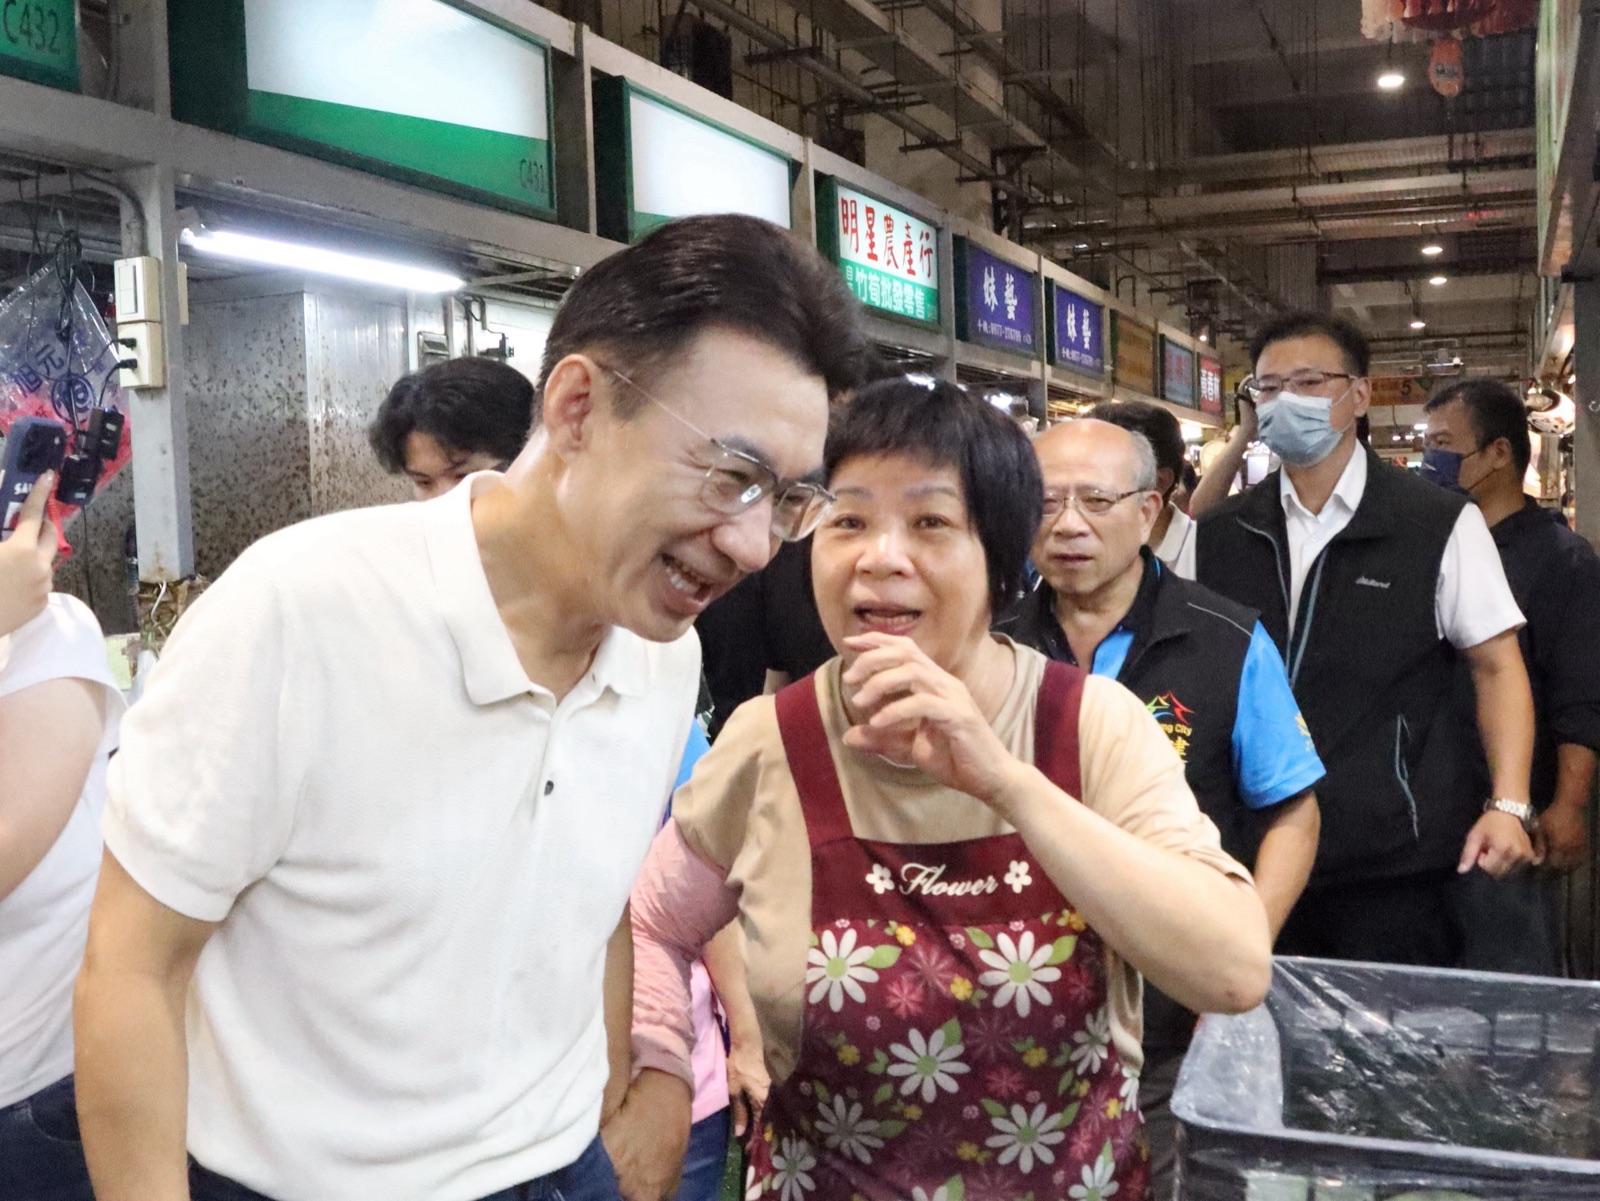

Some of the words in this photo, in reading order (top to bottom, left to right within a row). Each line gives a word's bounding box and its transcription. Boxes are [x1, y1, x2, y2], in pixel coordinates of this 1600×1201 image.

[3, 0, 61, 54] C432
[519, 158, 545, 193] C431
[841, 196, 933, 278] 明星農產行
[855, 266, 925, 320] 竹筍批發零售
[900, 862, 999, 896] Flower
